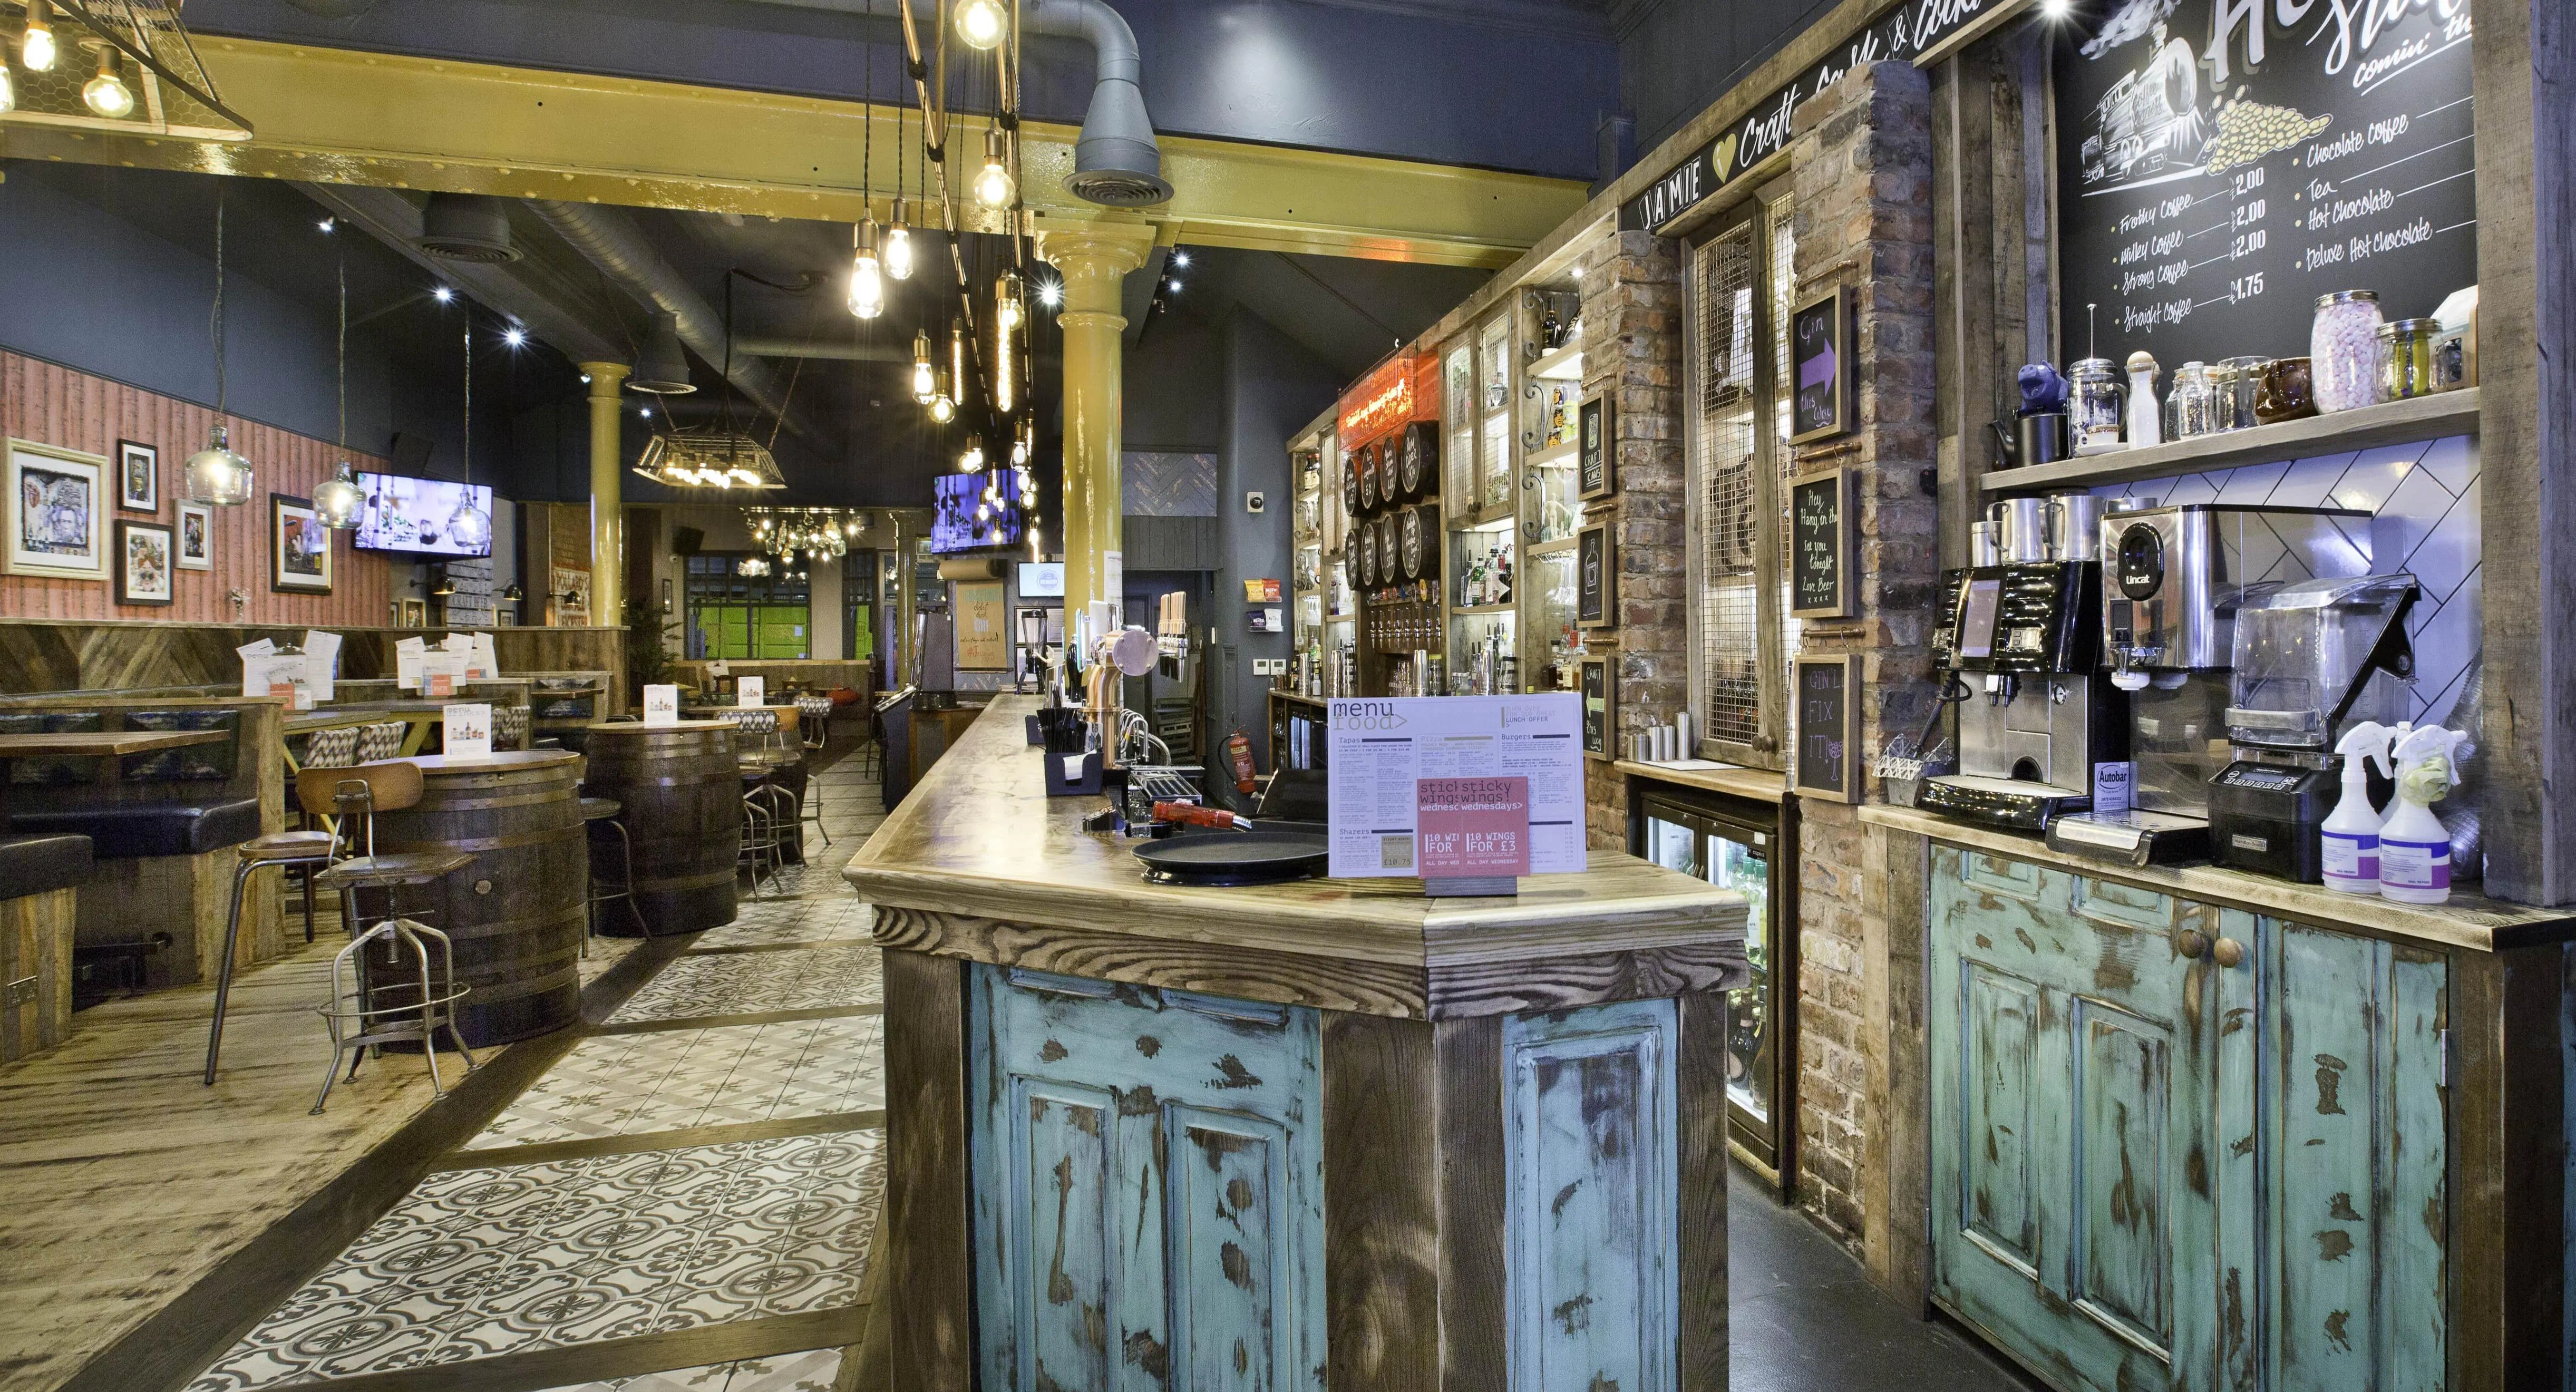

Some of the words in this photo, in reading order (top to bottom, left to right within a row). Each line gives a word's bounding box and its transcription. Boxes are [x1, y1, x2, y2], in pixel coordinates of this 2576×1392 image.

[1643, 163, 1700, 230] JAMIE
[1740, 83, 1801, 168] Craft
[2307, 131, 2364, 168] Chocolate
[2306, 178, 2337, 201] Tea
[2120, 208, 2156, 234] Frothy
[2161, 194, 2193, 218] Coffee
[2309, 203, 2330, 230] Hot
[2332, 188, 2394, 223] Chocolate
[2121, 241, 2149, 265] Milky
[2152, 230, 2184, 255] Coffee
[2306, 244, 2344, 271] Deluxe
[2349, 235, 2371, 262] Hot
[2123, 269, 2154, 295] Strong
[2157, 260, 2188, 284] Coffee
[2124, 303, 2161, 333] Straight
[2164, 298, 2192, 324] Coffee
[2228, 272, 2263, 305] £1.75
[1801, 394, 1815, 413] this
[1585, 449, 1601, 467] CRAFT
[1801, 508, 1819, 534] Hang
[1820, 513, 1827, 526] in
[1814, 541, 1827, 559] you
[1809, 555, 1834, 575] tonight
[1802, 576, 1815, 592] Love
[1818, 577, 1834, 591] Beer
[2126, 575, 2150, 585] Lincat
[1334, 703, 1394, 717] menu
[1809, 700, 1833, 723] FIX
[1587, 720, 1597, 735] this
[2099, 771, 2127, 783] Autobar
[1462, 780, 1511, 794] sticky
[1461, 792, 1509, 804] wings!
[1486, 832, 1515, 841] WINGS
[1430, 843, 1452, 852] FOR
[1471, 842, 1493, 852] FOR
[1501, 841, 1516, 851] £3
